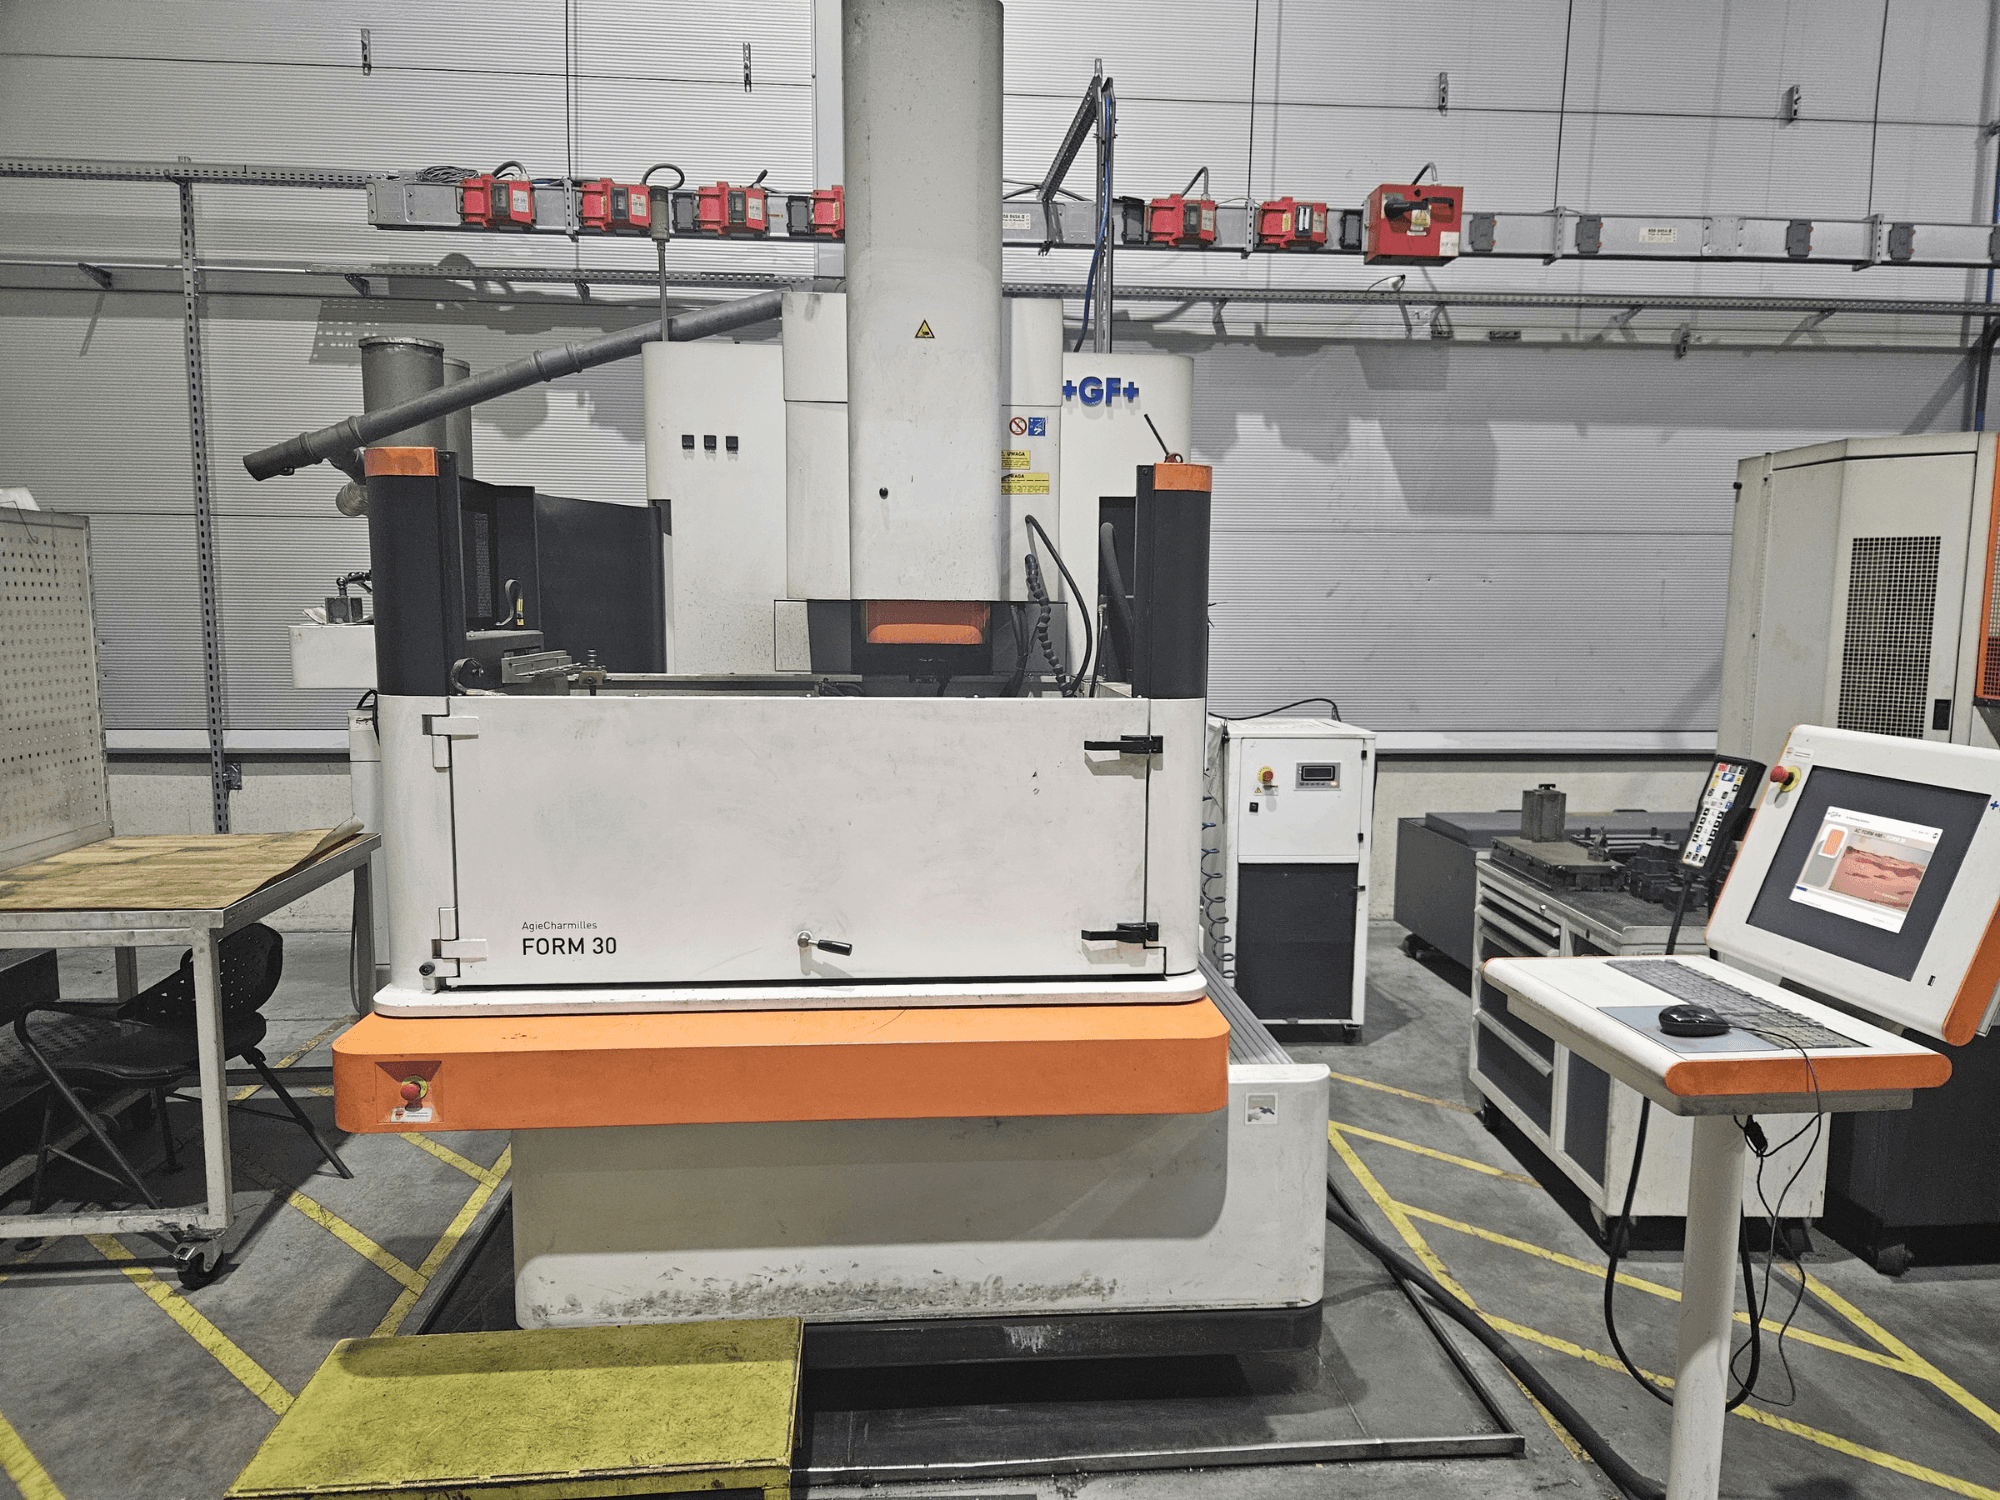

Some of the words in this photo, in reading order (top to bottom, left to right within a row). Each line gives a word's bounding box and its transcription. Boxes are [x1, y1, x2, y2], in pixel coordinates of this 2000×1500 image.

[522, 921, 597, 932] AgieCharmilles
[522, 937, 585, 955] FORM
[592, 937, 617, 955] 30
